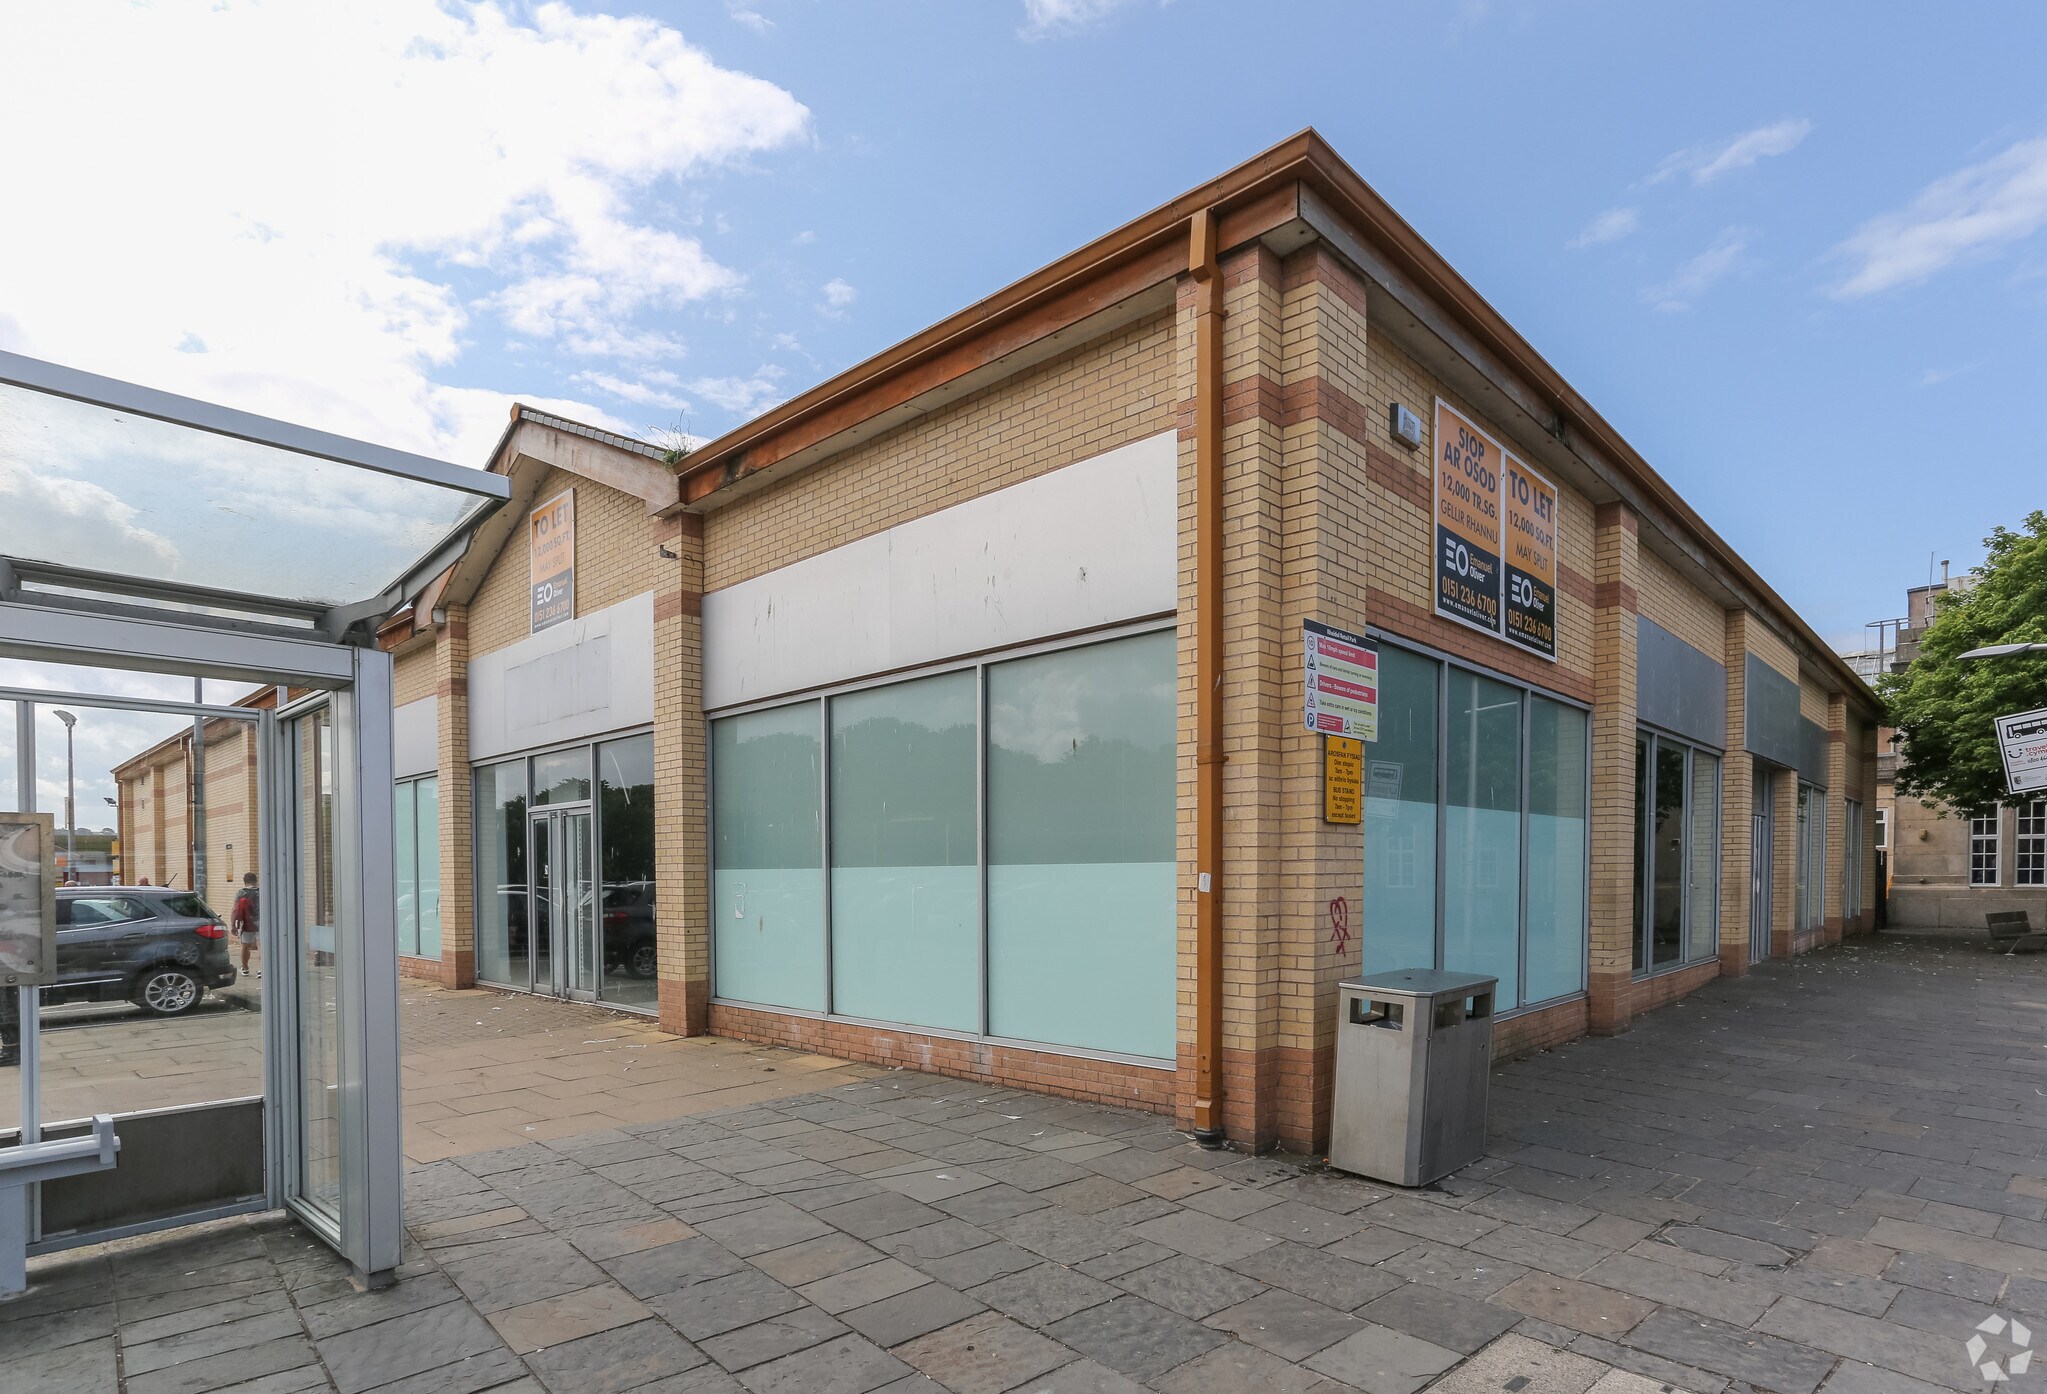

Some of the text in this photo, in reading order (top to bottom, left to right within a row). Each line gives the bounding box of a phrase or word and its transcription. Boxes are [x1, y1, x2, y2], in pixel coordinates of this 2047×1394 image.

[1459, 426, 1485, 461] SIOP
[1444, 441, 1496, 494] AR OSOD
[1442, 471, 1471, 503] 12,000
[1509, 468, 1553, 524] TO LET
[534, 501, 569, 539] TO LET
[1440, 499, 1498, 544] GELLIR RHANNU
[1509, 509, 1535, 538] 12,000
[539, 560, 551, 575] MAY
[1469, 552, 1493, 574] Emanuel
[1469, 565, 1486, 583] Oliver
[1515, 542, 1548, 573] MAY SPLIT
[1442, 575, 1497, 616] 0151 236 6700
[1508, 608, 1552, 642] 0151 236 6700
